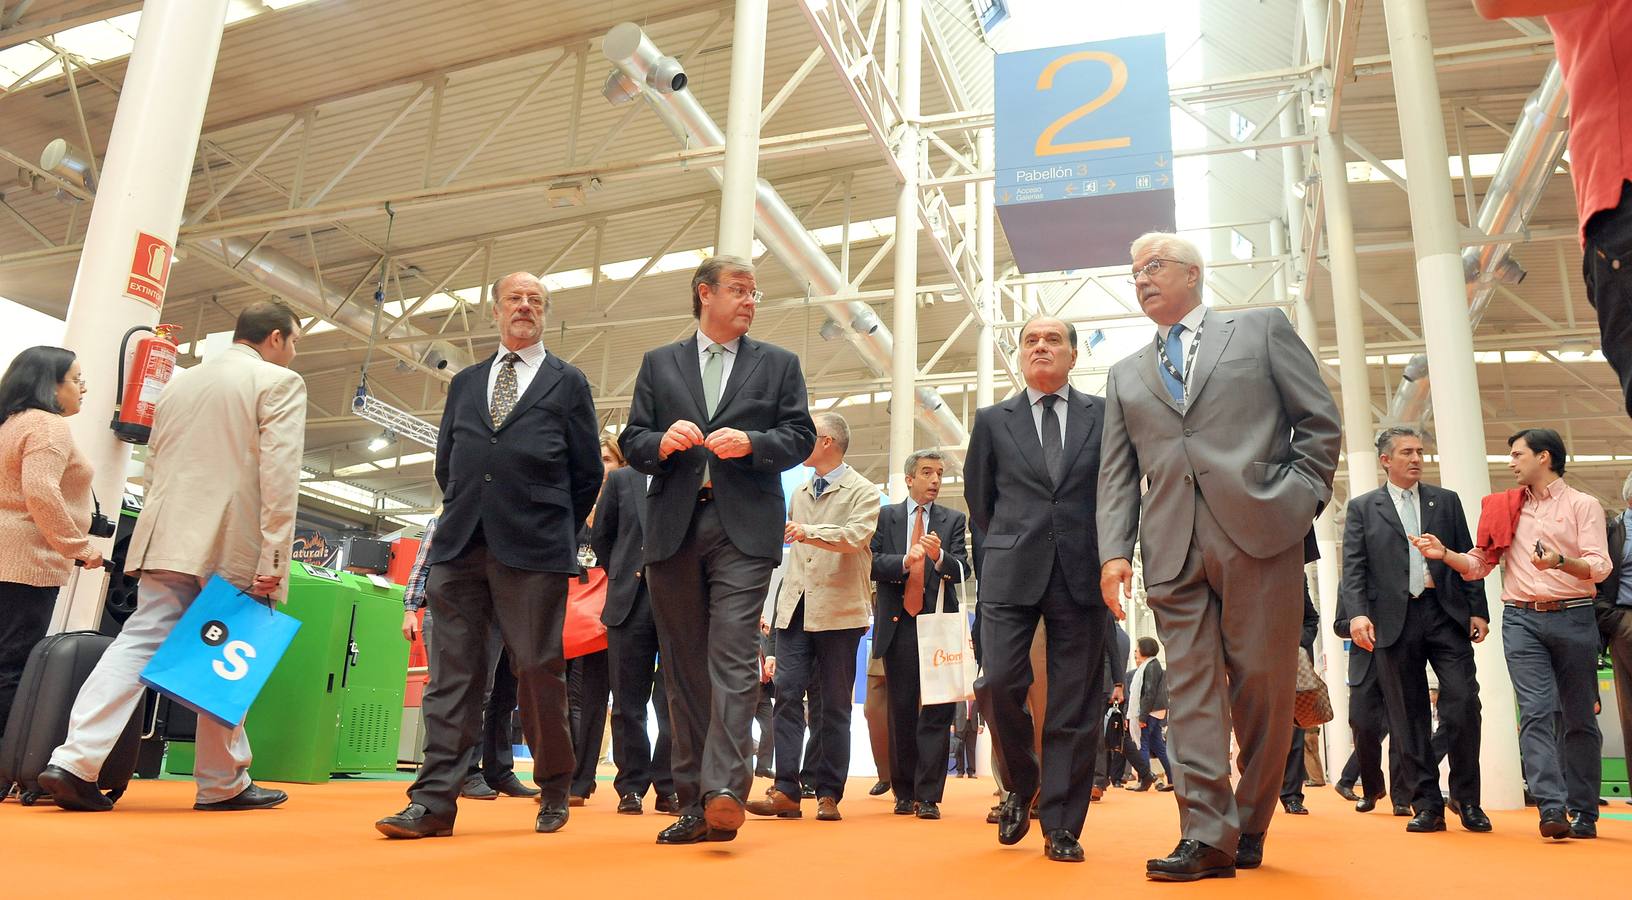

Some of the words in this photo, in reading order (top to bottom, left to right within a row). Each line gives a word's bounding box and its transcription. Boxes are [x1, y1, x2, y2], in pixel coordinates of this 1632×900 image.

[1036, 51, 1131, 156] 2
[1016, 166, 1072, 183] Pabellón
[1077, 164, 1088, 176] 3
[291, 542, 324, 559] atural
